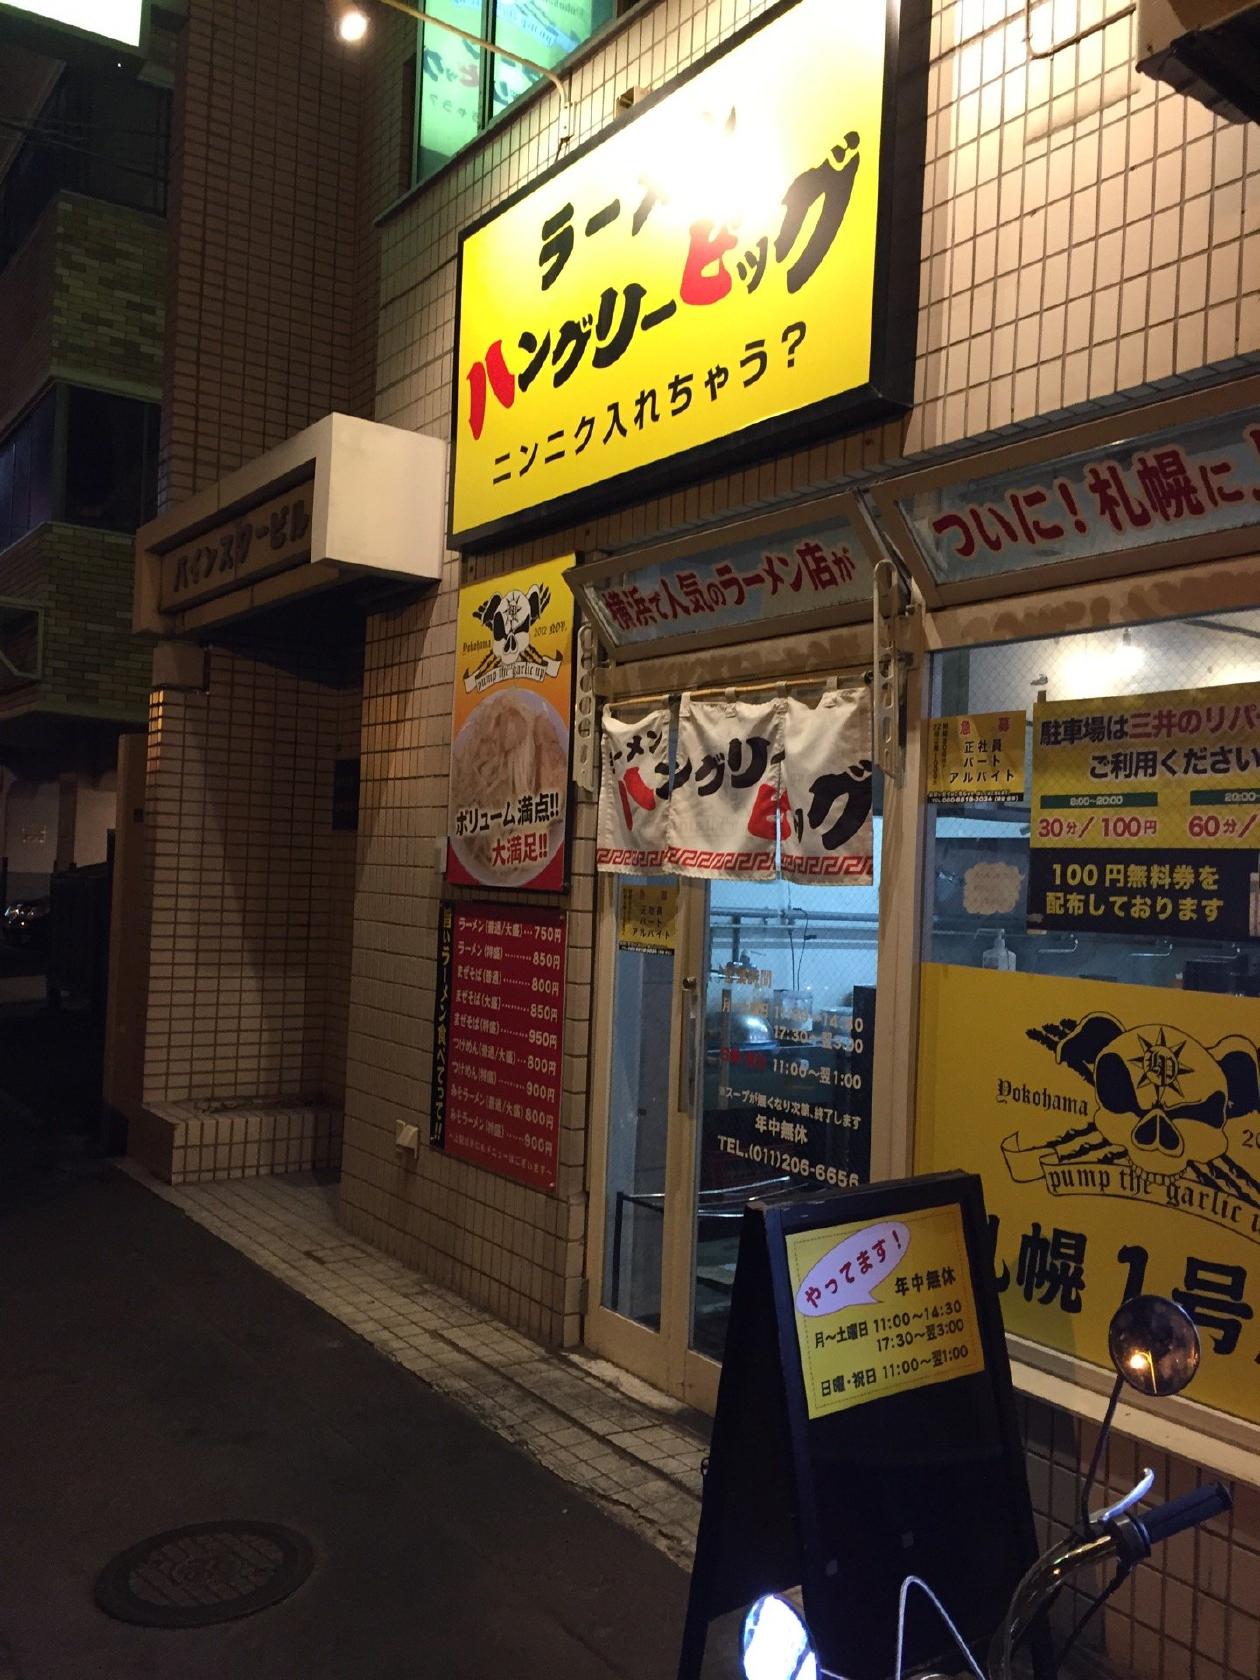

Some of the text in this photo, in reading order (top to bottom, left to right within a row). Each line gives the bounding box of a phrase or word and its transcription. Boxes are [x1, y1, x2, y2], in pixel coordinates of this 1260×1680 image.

[492, 321, 807, 485] ニンニク入れちゃう?
[932, 430, 1260, 556] ついに!札幌に
[964, 739, 1001, 754] 正社員
[949, 769, 1015, 783] アルバイト
[1089, 747, 1260, 780] ご利用ください
[456, 792, 560, 836] ボリューム満点!!
[492, 832, 548, 867] 大満足!!
[1046, 892, 1223, 922] 配布しております
[534, 926, 562, 943] 750円
[532, 952, 560, 970] 850円
[531, 977, 559, 997] 800円
[530, 1003, 558, 1023] 850円
[528, 1029, 558, 1049] 950円
[527, 1055, 557, 1077] 800円
[526, 1081, 555, 1103] 900円
[996, 1078, 1089, 1117] Yokohama
[525, 1108, 554, 1130] 800円
[754, 1114, 809, 1144] 年中無休
[524, 1134, 553, 1157] 900円
[1050, 1168, 1111, 1189] pump
[1166, 1177, 1243, 1223] garlic
[804, 1229, 902, 1309] やってます!
[894, 1266, 957, 1297] 年中無休
[815, 1300, 963, 1349] 月～土曜日 11:00～14:30
[877, 1319, 964, 1352] 17:30～翌3:00
[883, 1346, 969, 1379] 11:00～翌1:00
